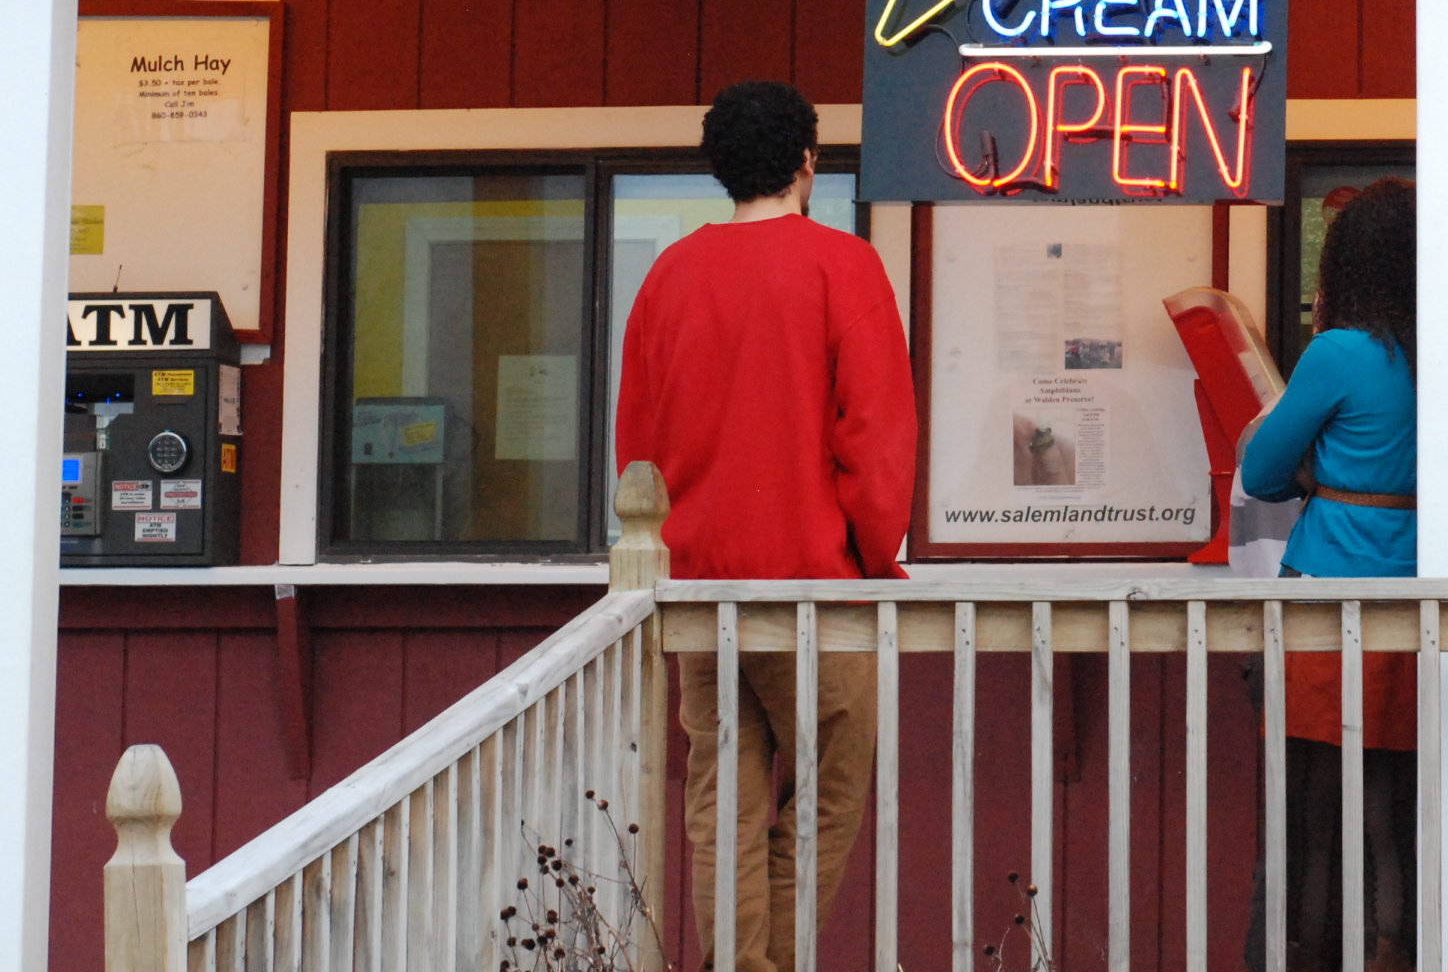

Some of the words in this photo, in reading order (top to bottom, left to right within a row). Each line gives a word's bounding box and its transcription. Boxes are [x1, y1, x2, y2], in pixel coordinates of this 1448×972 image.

[130, 55, 184, 73] Mulch
[194, 54, 231, 75] Hay
[944, 62, 1254, 196] OPEN
[945, 505, 1196, 526] www.salemlandtrust.org
